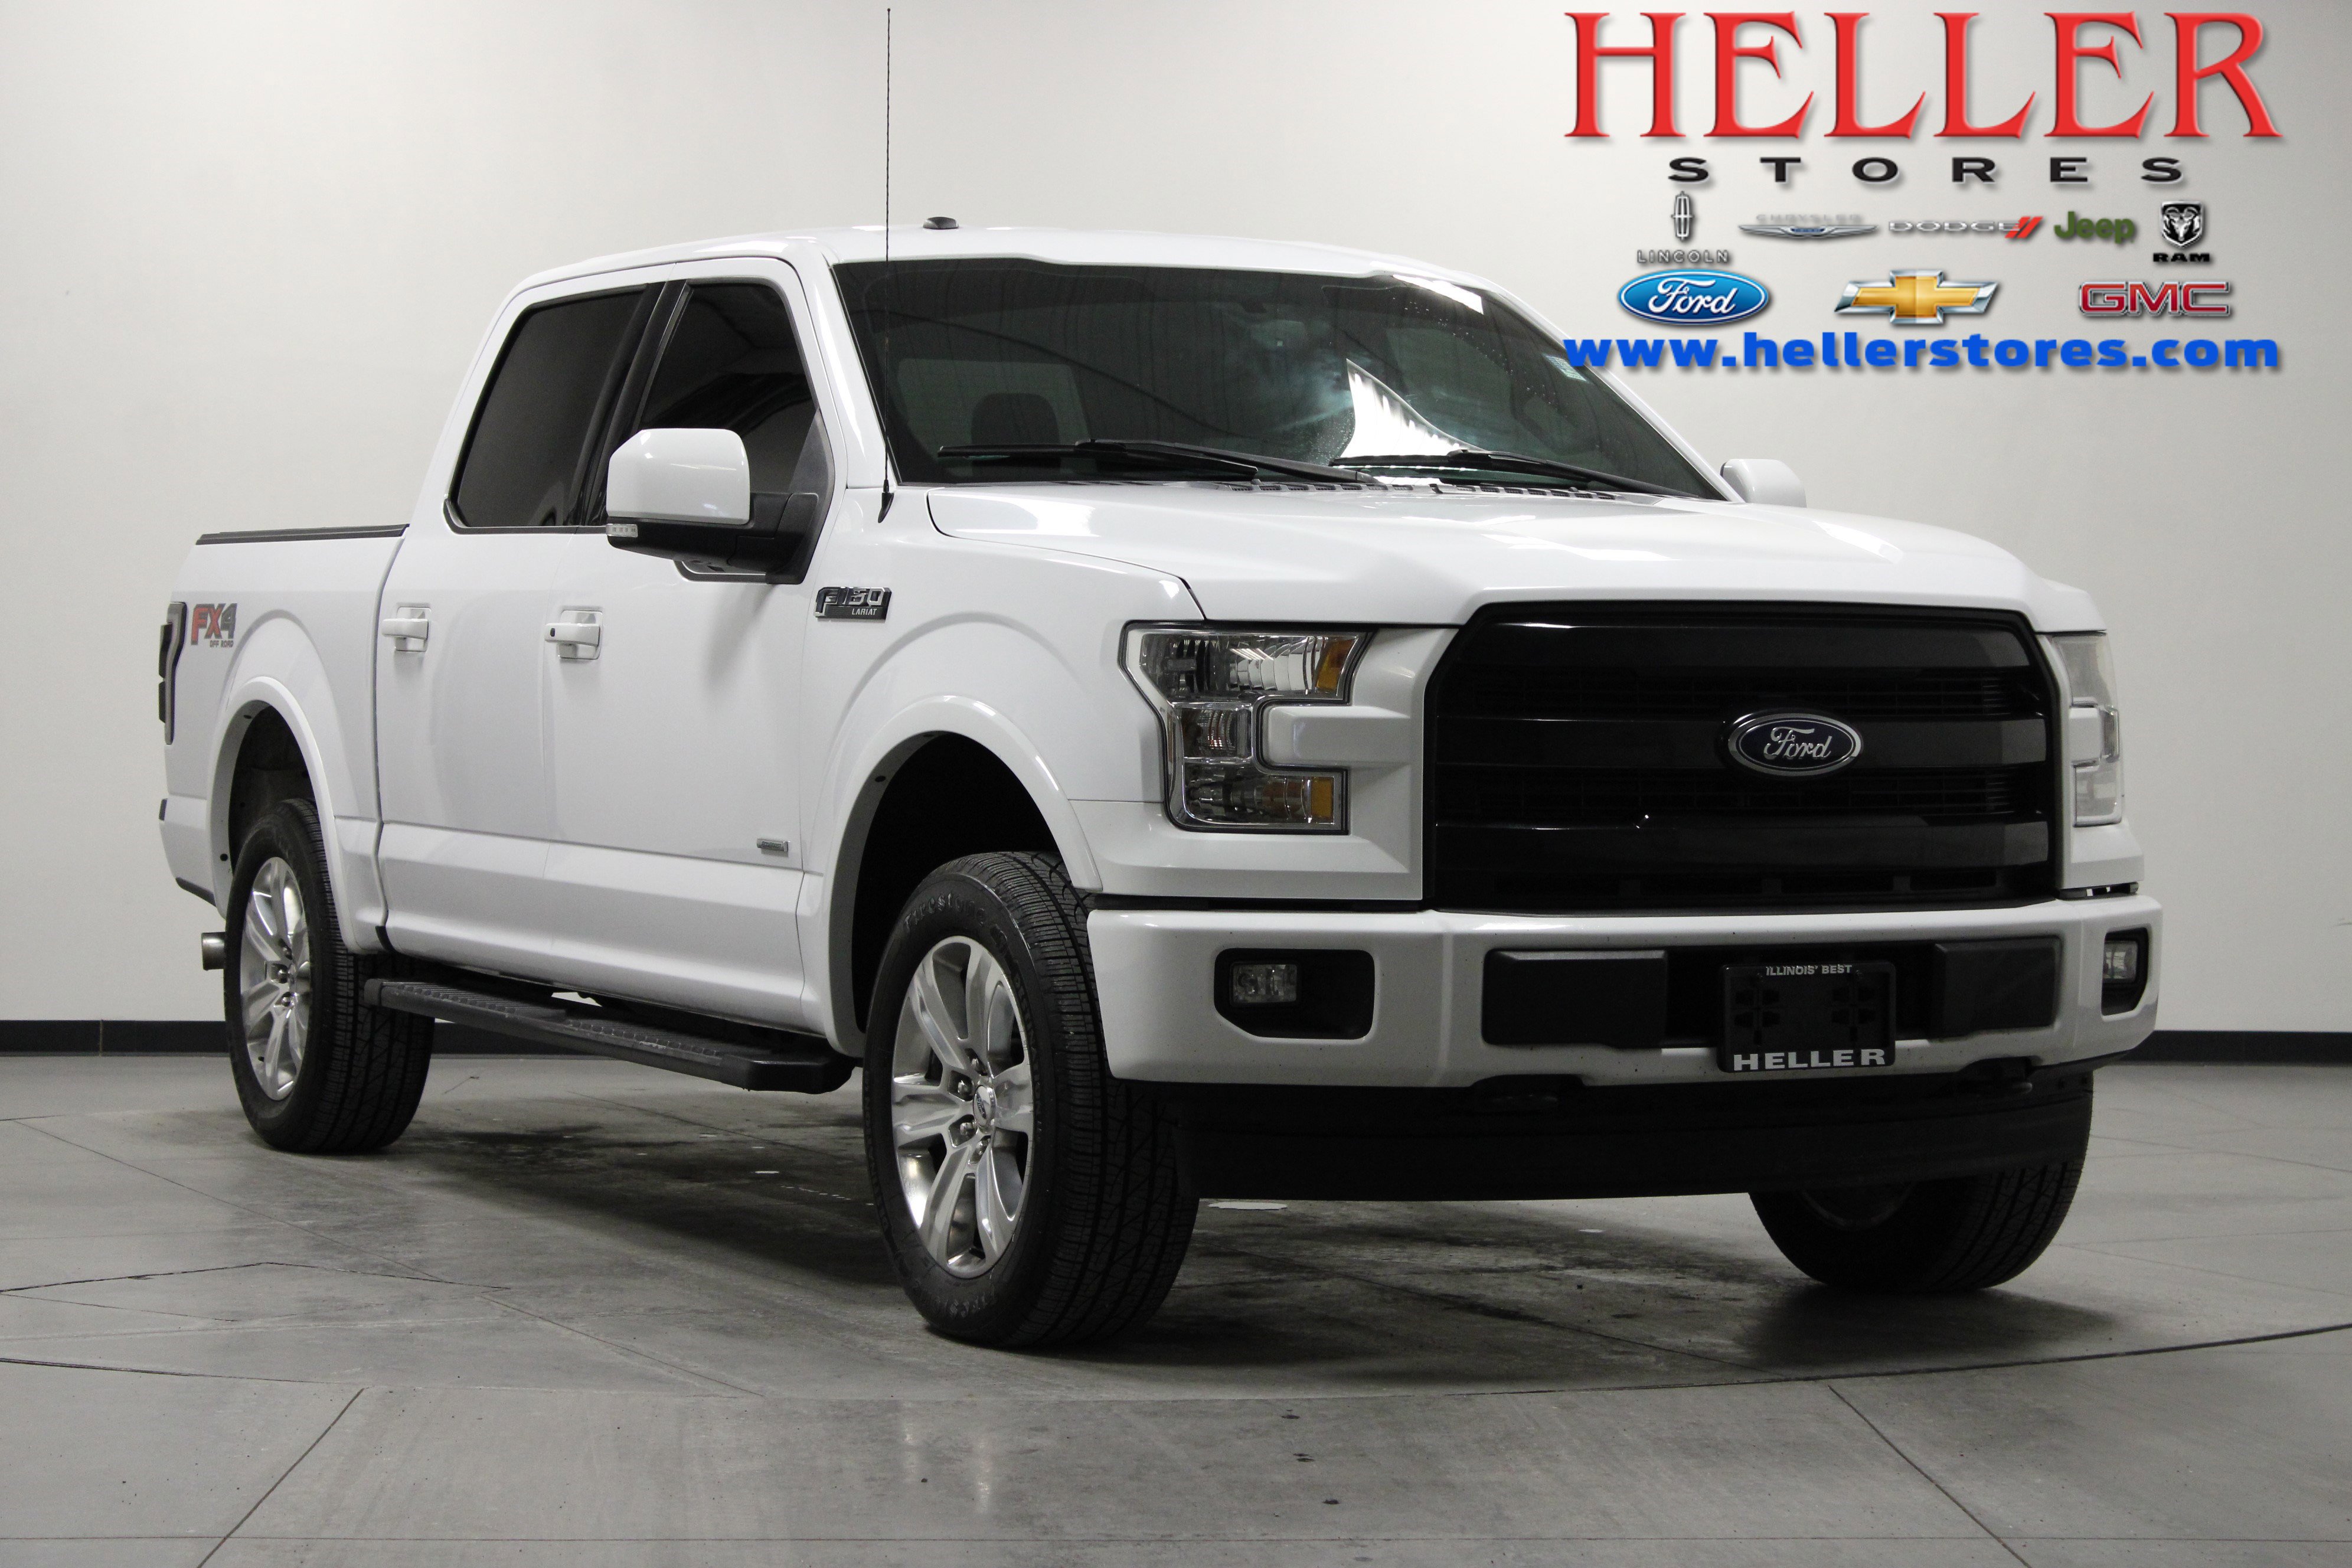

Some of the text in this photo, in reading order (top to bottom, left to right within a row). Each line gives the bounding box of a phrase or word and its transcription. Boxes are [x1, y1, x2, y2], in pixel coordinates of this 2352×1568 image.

[191, 603, 237, 645] FX4
[1763, 726, 1832, 760] Ford
[1821, 964, 1852, 974] BEST
[1733, 1048, 1885, 1071] HELLER
